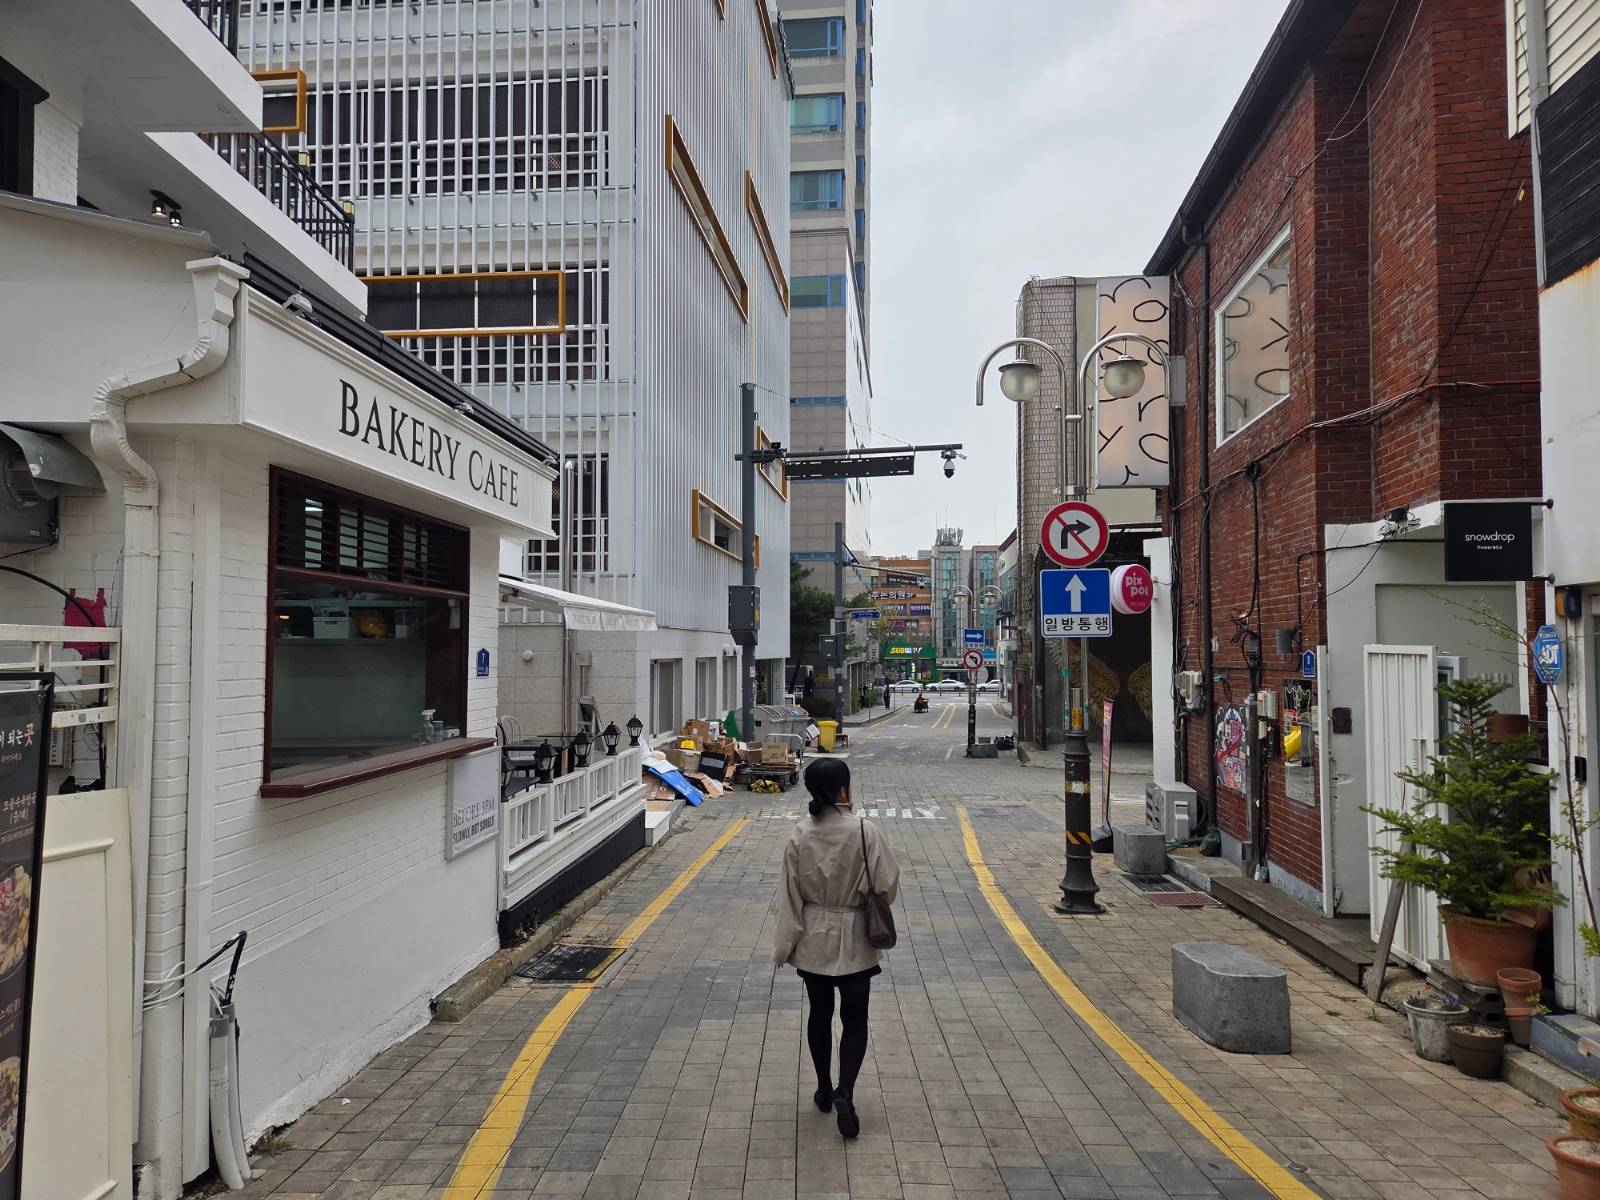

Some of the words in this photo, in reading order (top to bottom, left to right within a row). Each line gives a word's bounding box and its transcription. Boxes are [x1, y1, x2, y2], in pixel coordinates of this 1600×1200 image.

[339, 379, 461, 480] BAKERY
[469, 450, 519, 507] CAFE
[1464, 530, 1515, 544] snowdrop
[1126, 572, 1143, 587] pix
[1045, 616, 1108, 632] 일방통행
[1538, 644, 1560, 665] ADT
[453, 802, 481, 828] BEFORE
[453, 826, 471, 845] SLOWLY
[471, 821, 480, 836] BUT
[480, 815, 495, 832] SURELY
